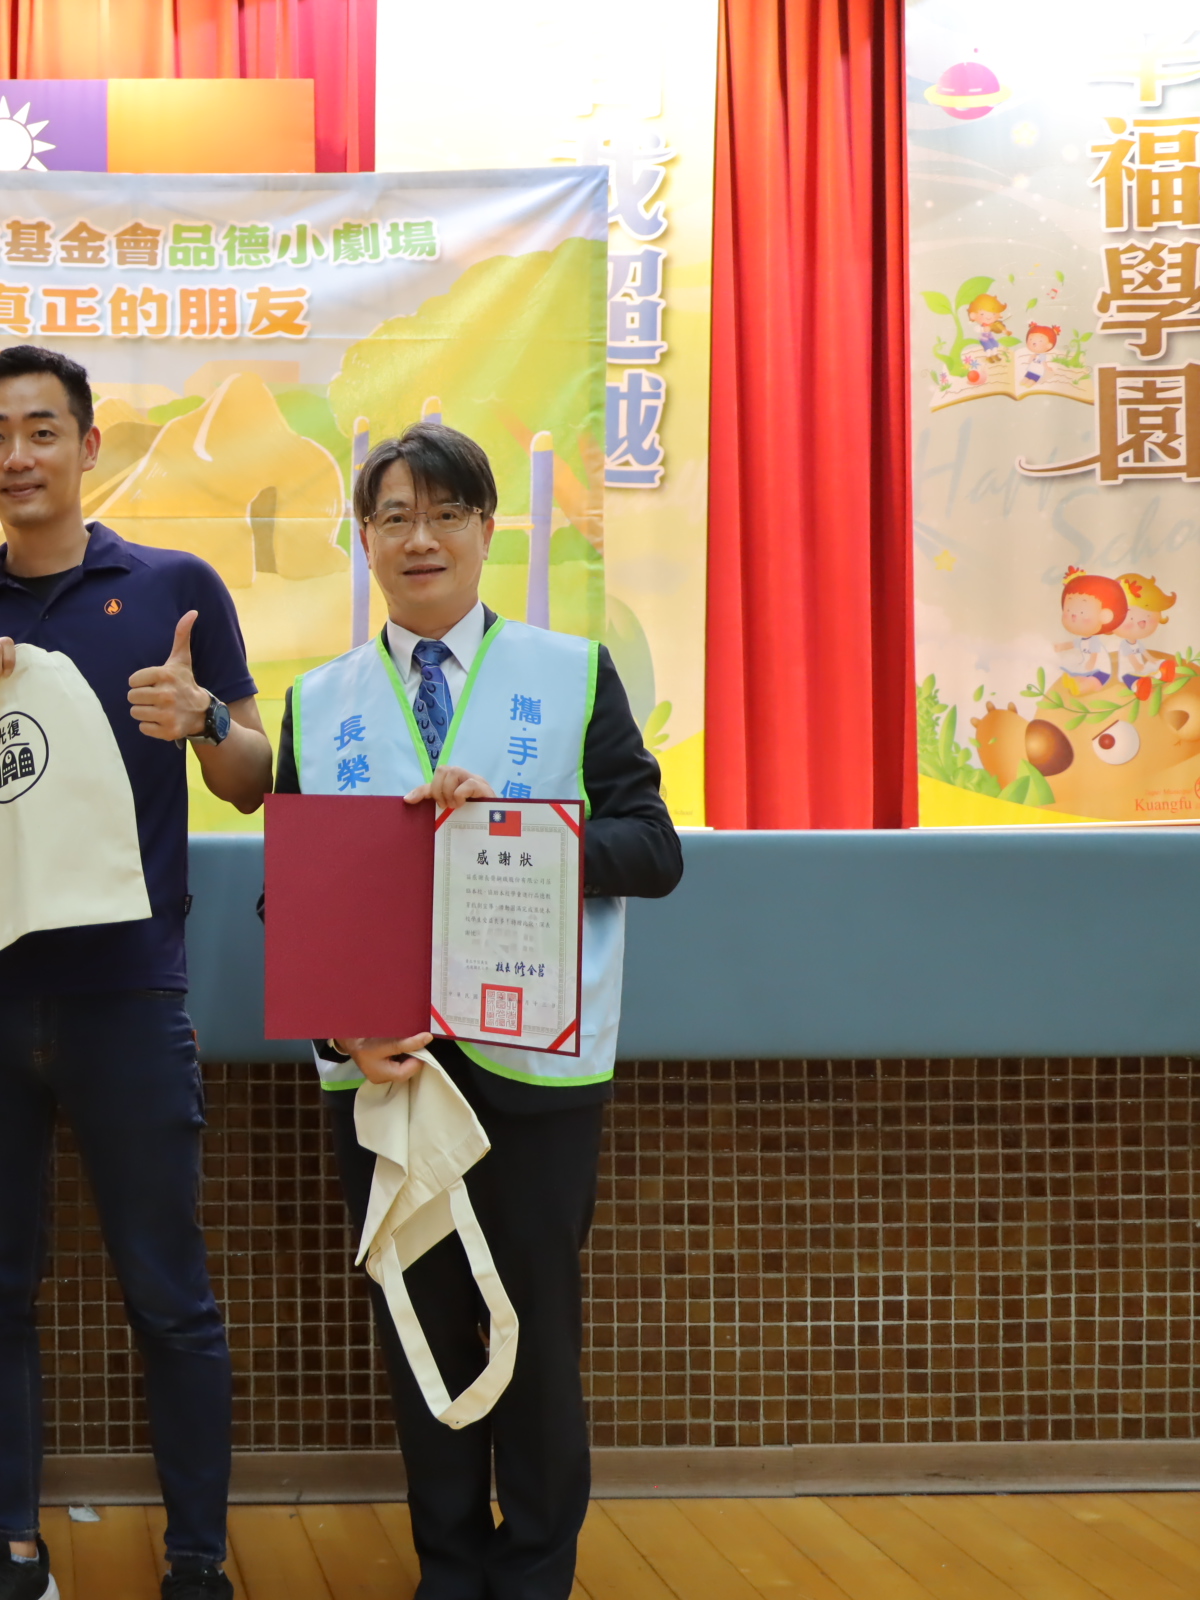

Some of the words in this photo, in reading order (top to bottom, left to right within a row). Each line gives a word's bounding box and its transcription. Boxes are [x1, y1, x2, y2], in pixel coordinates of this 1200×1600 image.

[334, 714, 371, 792] 長榮
[1134, 796, 1193, 814] Kuangfu
[476, 849, 534, 868] 感謝狀
